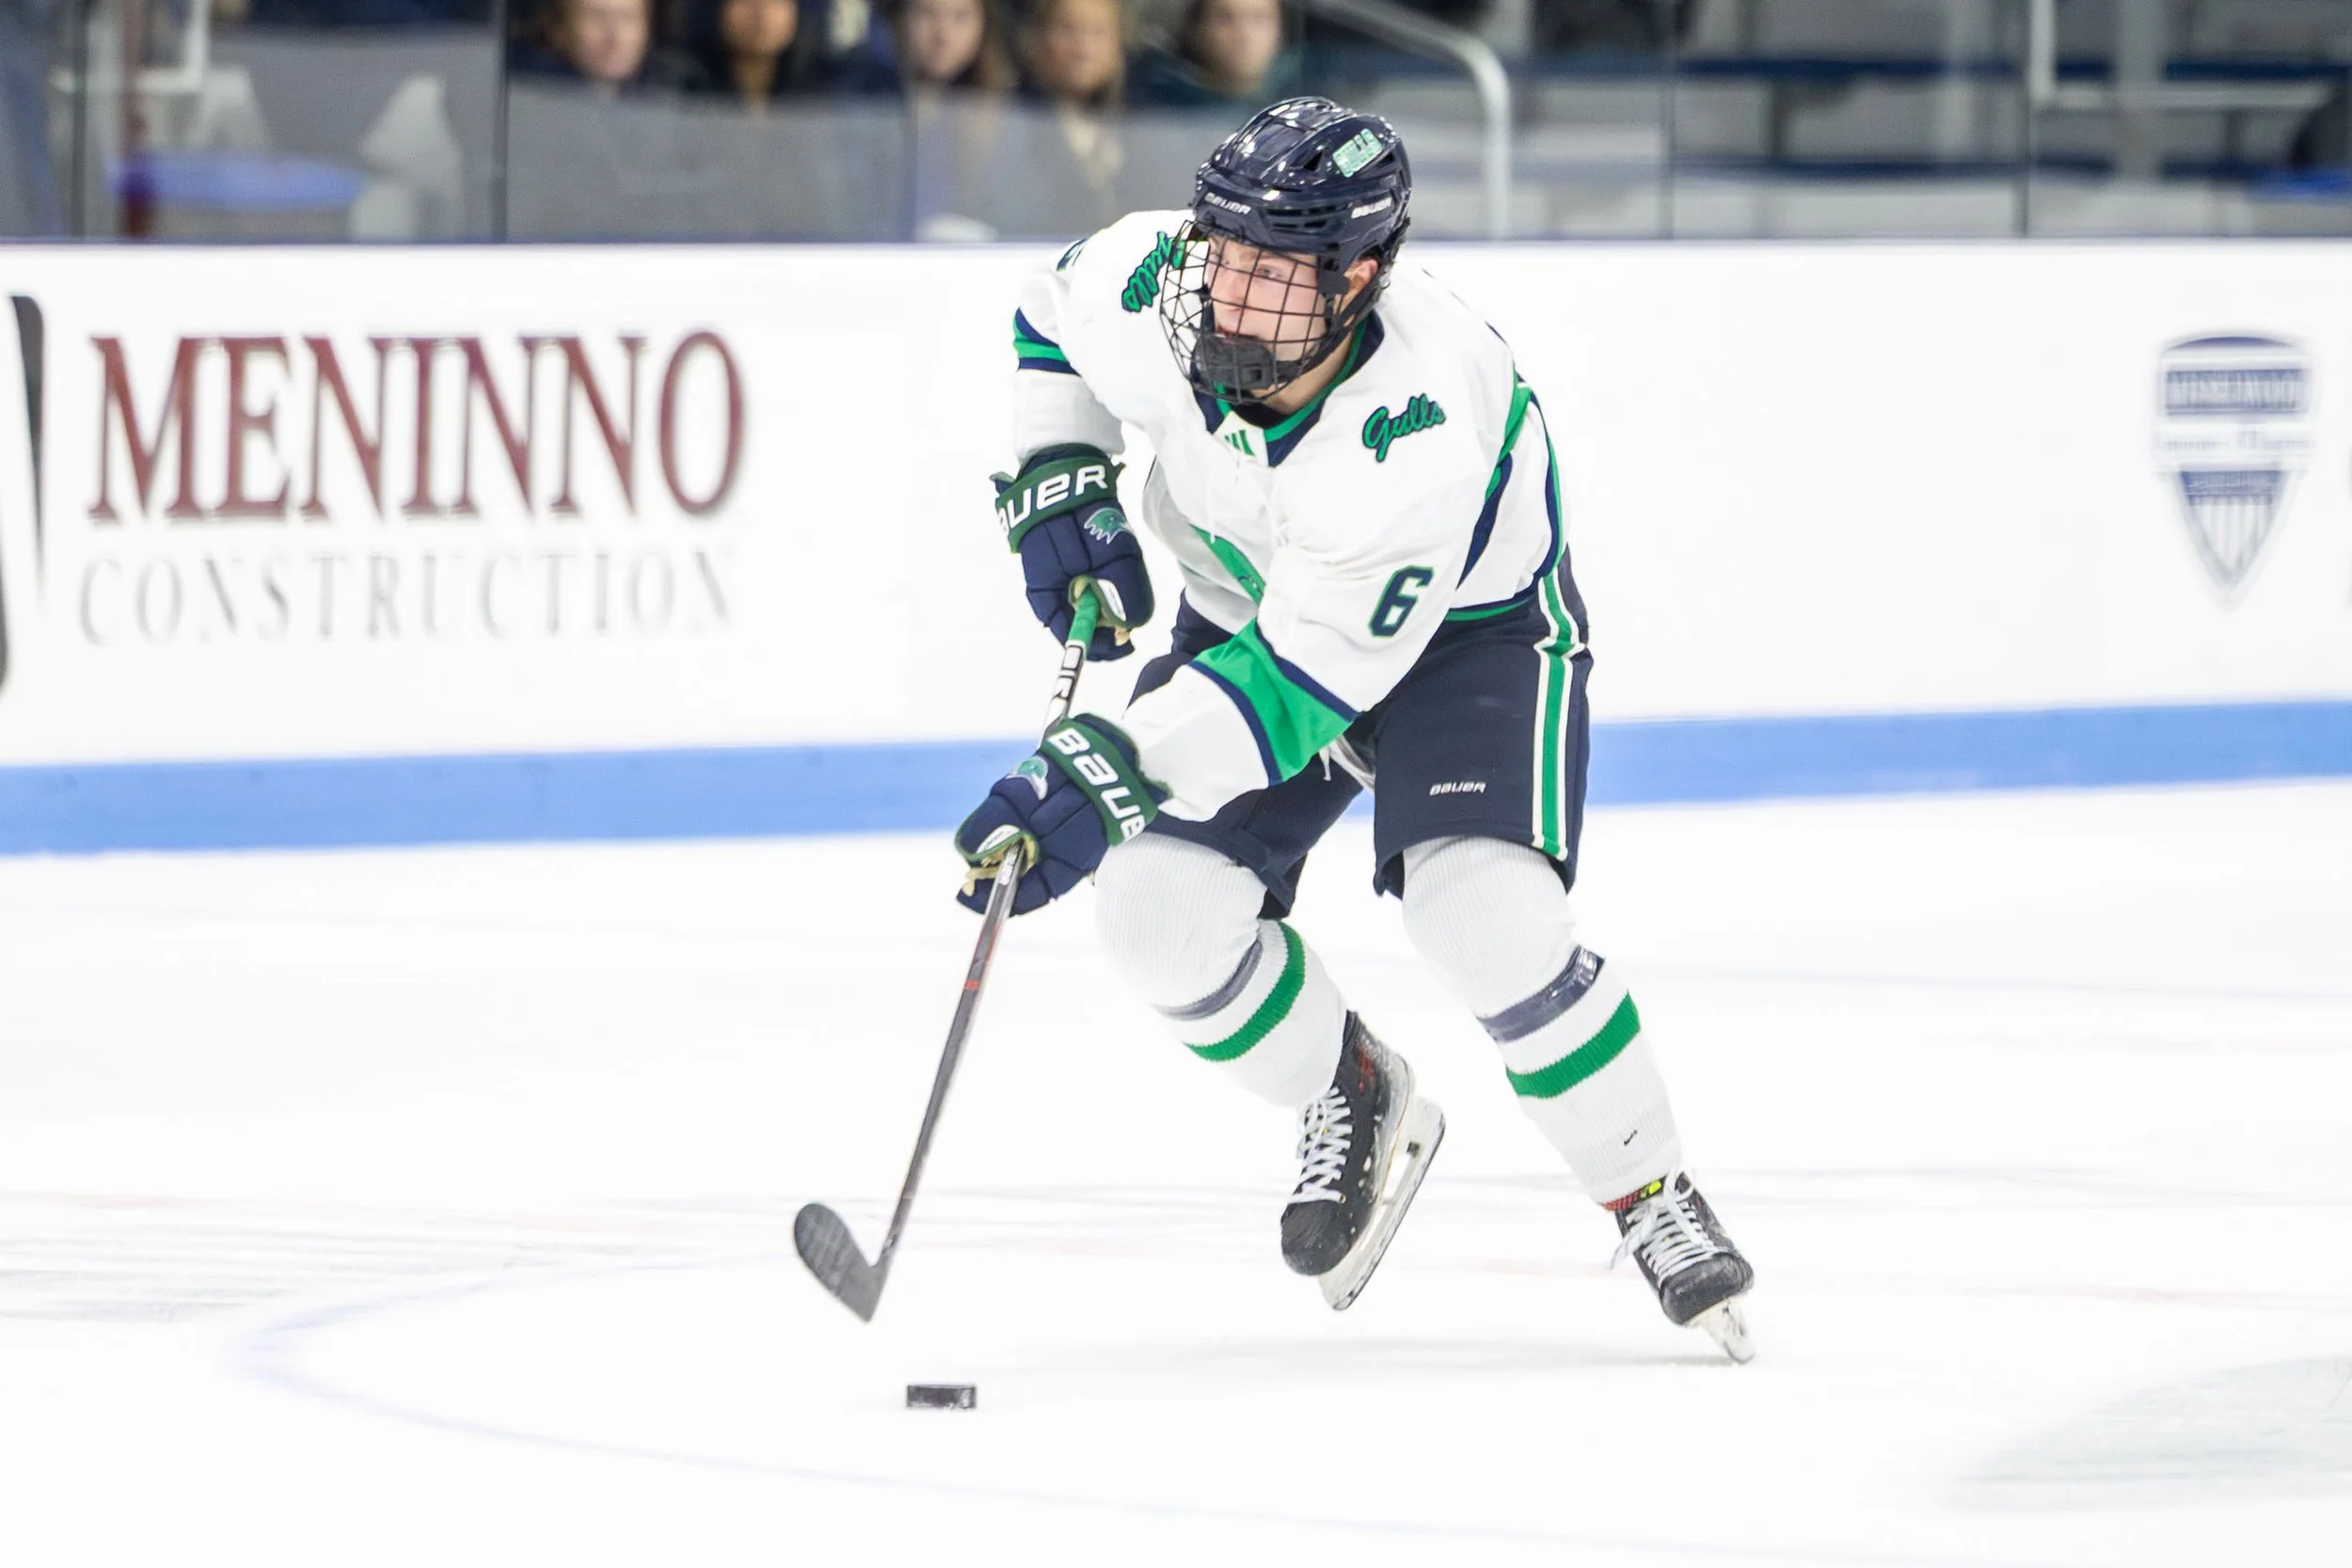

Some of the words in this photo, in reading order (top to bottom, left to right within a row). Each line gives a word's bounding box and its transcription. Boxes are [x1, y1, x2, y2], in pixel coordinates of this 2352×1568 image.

[87, 329, 749, 520] MENINNO
[1362, 393, 1446, 463] Gulls
[78, 548, 734, 646] CONSTRUCTION
[1368, 565, 1434, 639] 6
